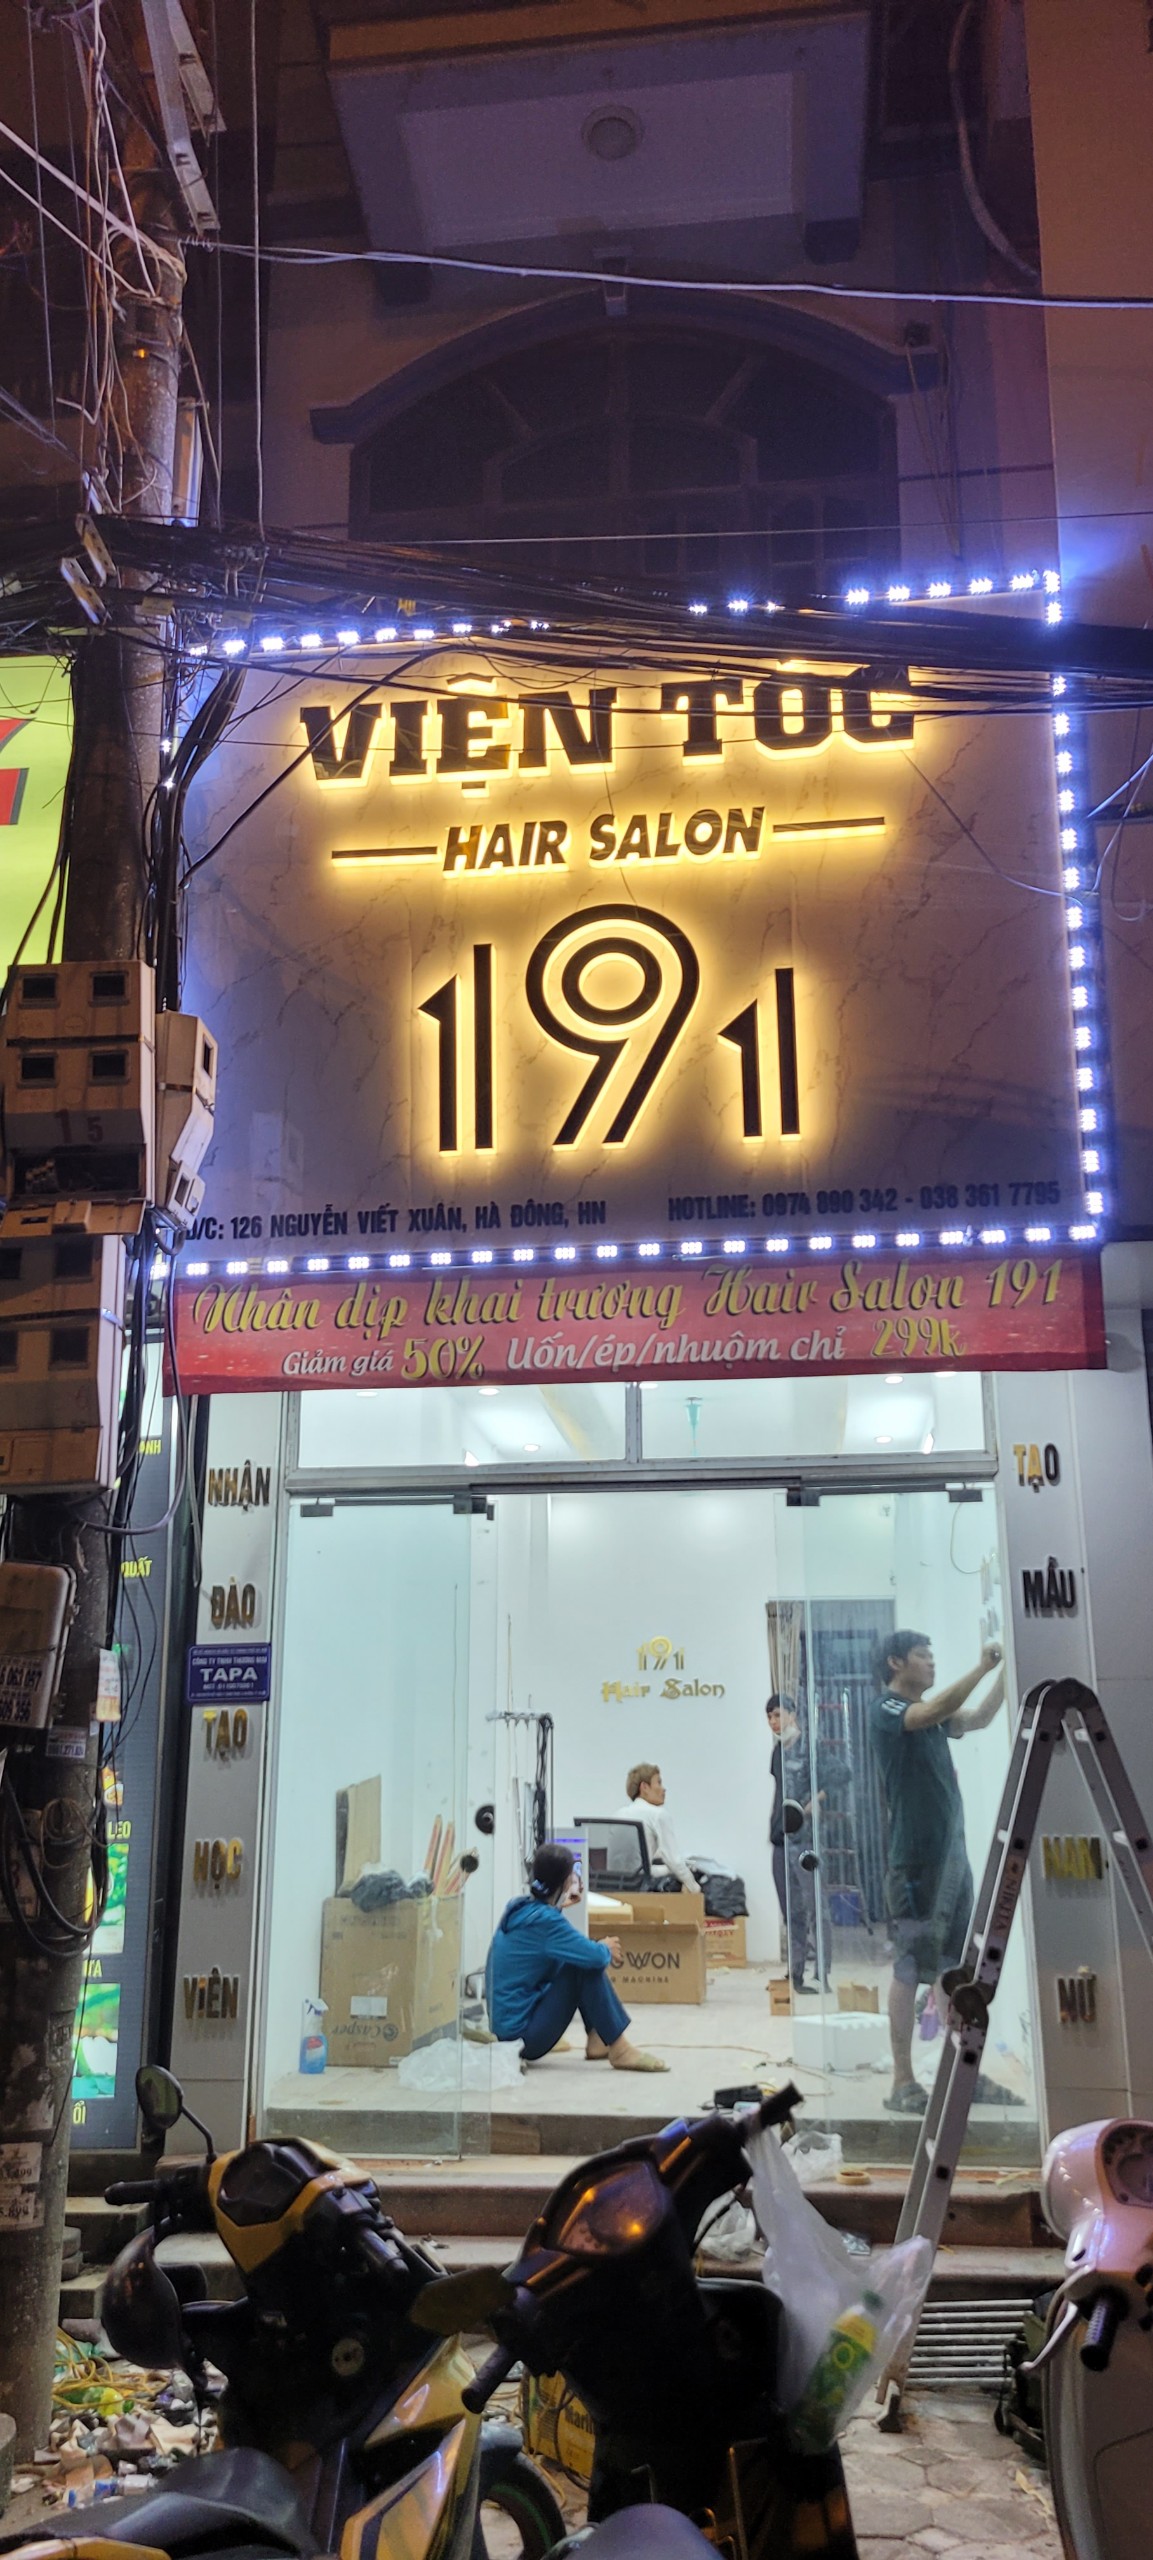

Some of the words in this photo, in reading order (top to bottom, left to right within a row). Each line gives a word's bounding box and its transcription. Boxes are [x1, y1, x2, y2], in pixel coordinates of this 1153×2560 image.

[300, 672, 618, 790] VIỆN
[443, 820, 568, 872] HAIR
[590, 806, 765, 861] SALON
[417, 903, 800, 1153] 191
[230, 1215, 262, 1239] 126
[270, 1204, 348, 1238] NGUYỄN
[358, 1202, 399, 1234] VIẾT
[408, 1203, 467, 1233] XUÂN,
[475, 1201, 501, 1229] HÀ
[510, 1199, 569, 1228] ĐÔNG,
[578, 1201, 606, 1224] HN
[668, 1194, 756, 1220] HOTLINE:
[859, 1187, 898, 1212] 342
[194, 1281, 323, 1334] Nhân
[335, 1278, 408, 1341] dịp
[424, 1273, 524, 1326] khai
[538, 1277, 686, 1329] trương
[701, 1262, 818, 1317] Hair
[831, 1256, 968, 1312] Salon
[985, 1257, 1063, 1309] 191
[282, 1348, 348, 1376] Giảm
[350, 1349, 395, 1376] giá
[402, 1335, 486, 1381] 50%
[789, 1325, 845, 1361] chỉ
[208, 1459, 271, 1511] NHẬN
[1013, 1443, 1061, 1493] TẠO
[199, 1667, 259, 1682] TAPA
[636, 1636, 686, 1671] 191
[601, 1680, 651, 1703] Hair
[660, 1678, 725, 1700] Salon
[203, 1708, 249, 1761] TẠO
[193, 1839, 243, 1889] HỌC
[183, 1967, 239, 2019] VIÊN
